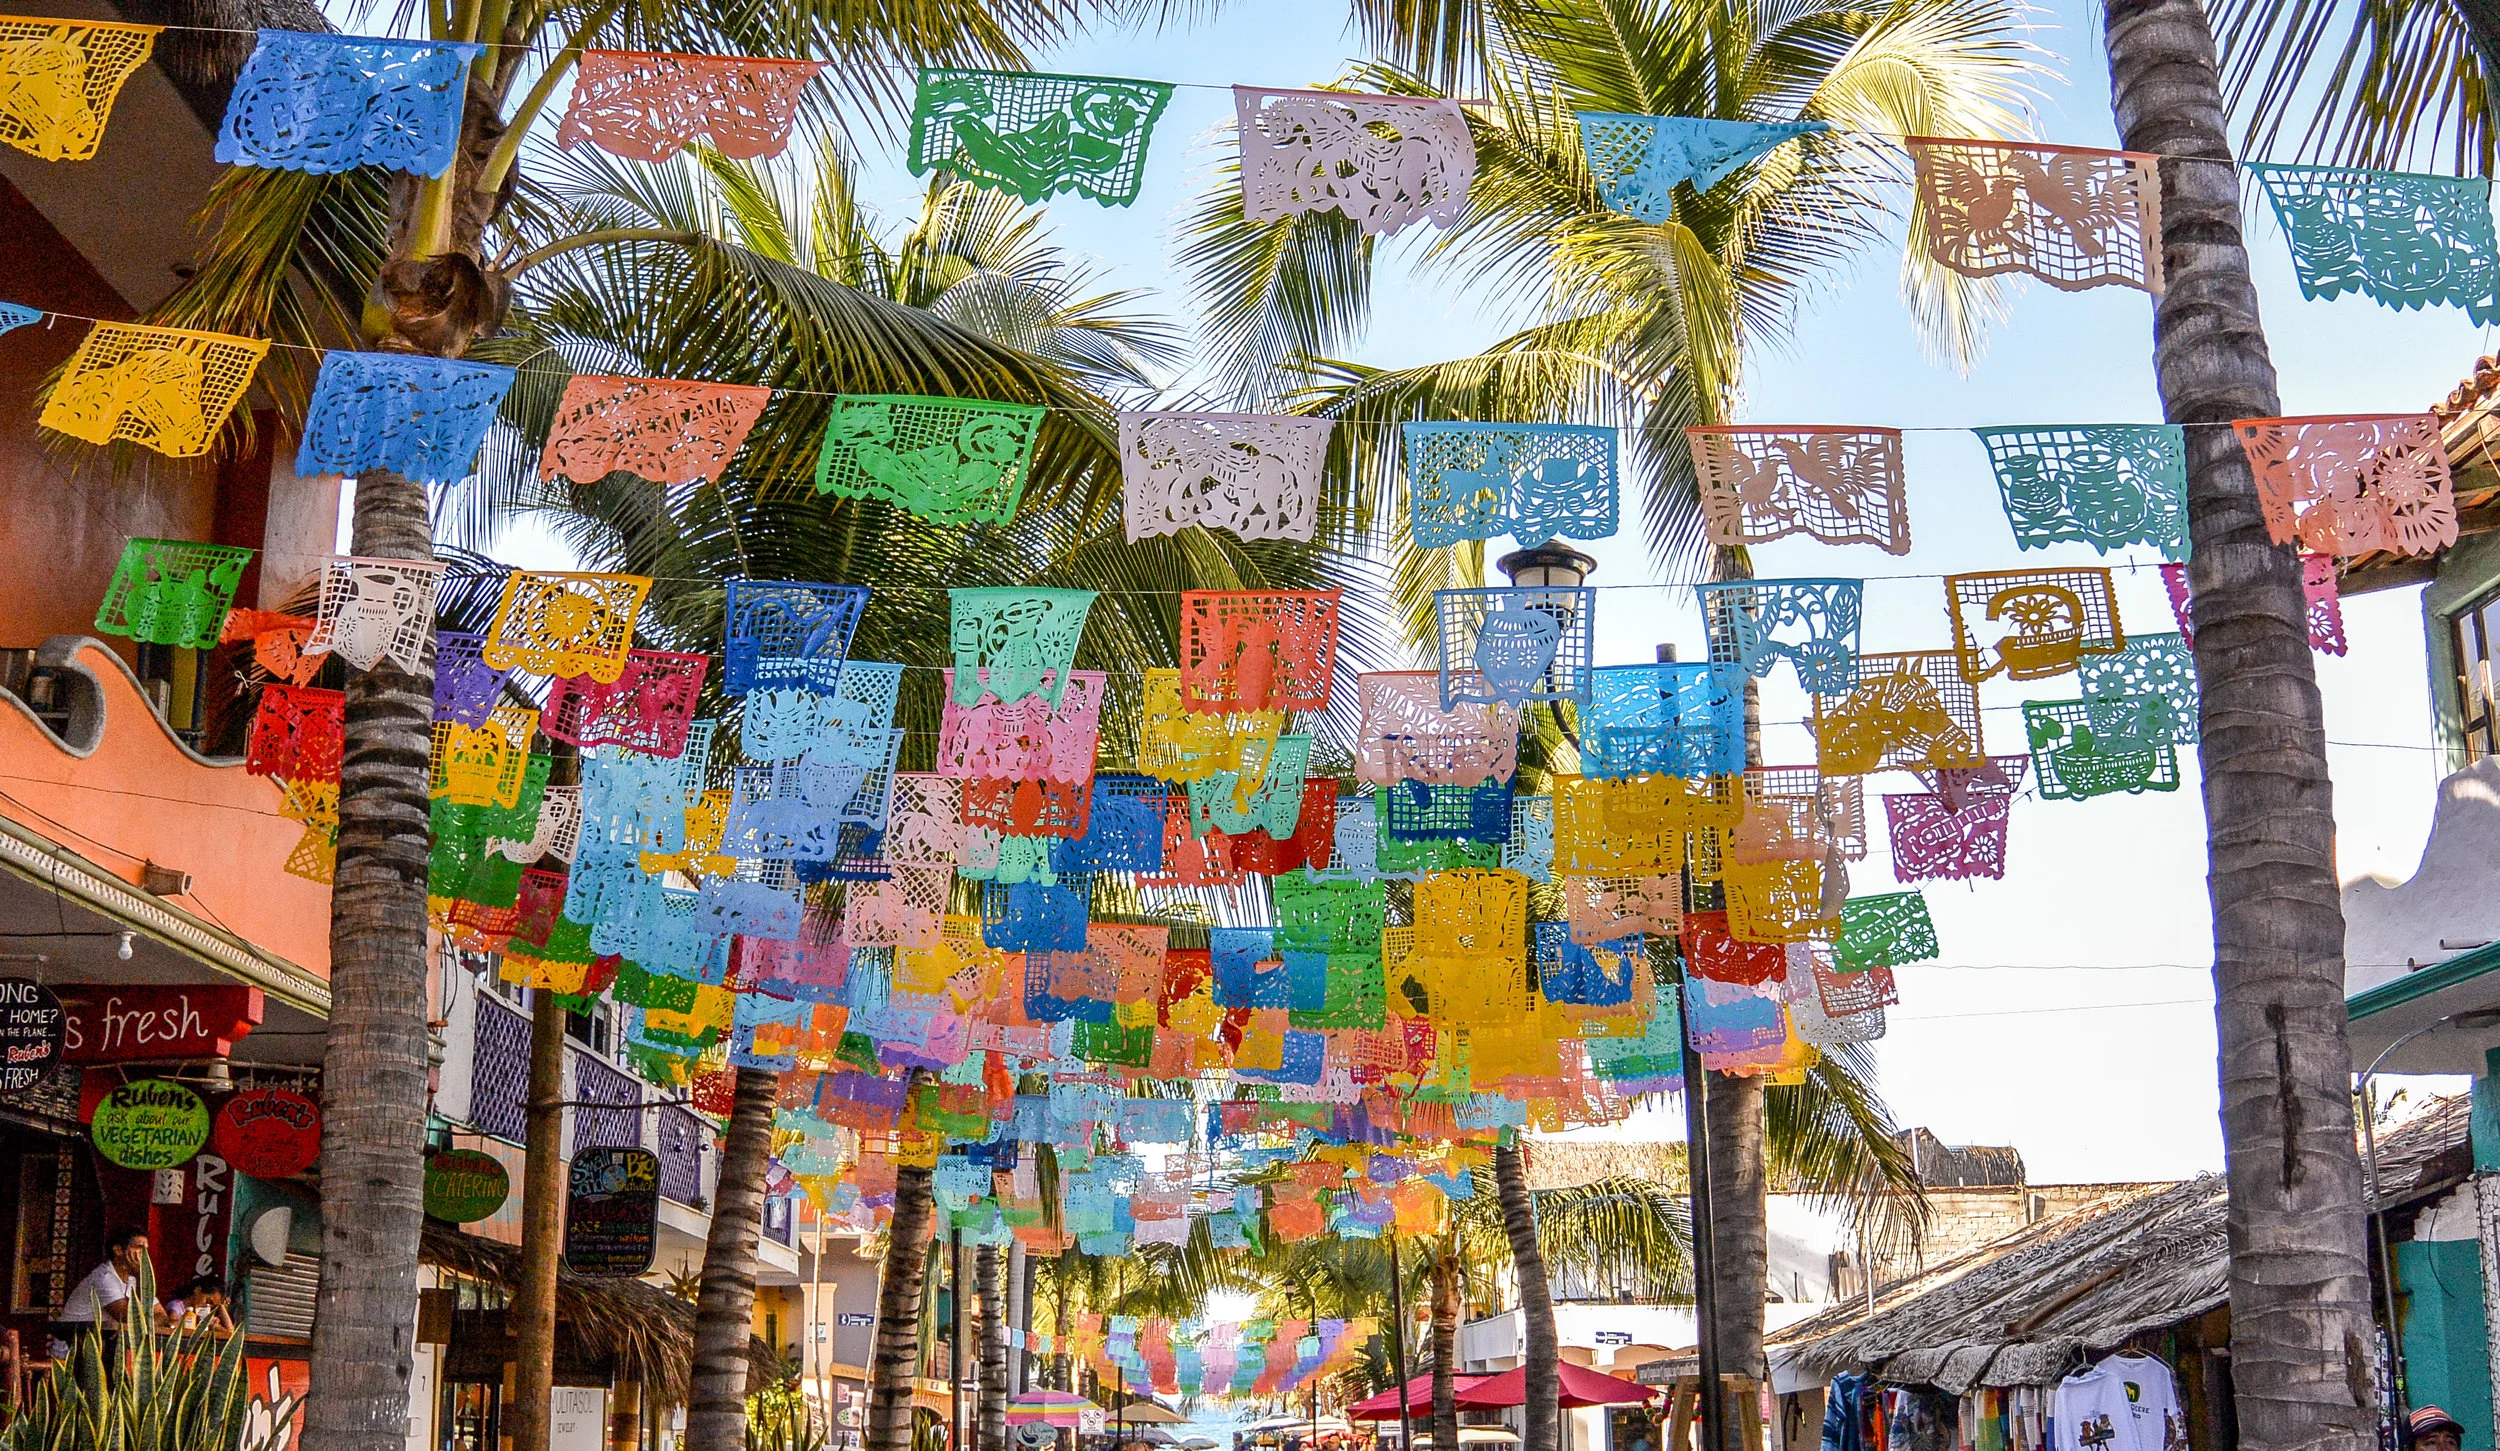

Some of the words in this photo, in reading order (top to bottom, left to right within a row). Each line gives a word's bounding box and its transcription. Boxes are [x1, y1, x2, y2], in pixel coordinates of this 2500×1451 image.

[10, 1008, 59, 1024] HOME?
[101, 995, 208, 1051] fresh
[5, 1067, 39, 1090] FRESH
[111, 1081, 197, 1111] Ruben's
[106, 1111, 128, 1125] ask
[136, 1111, 167, 1126] about
[172, 1114, 193, 1126] our
[100, 1126, 201, 1147] VEGETARIAN
[119, 1146, 173, 1164] dishes
[626, 1152, 656, 1181] Big
[432, 1172, 507, 1198] CATERING
